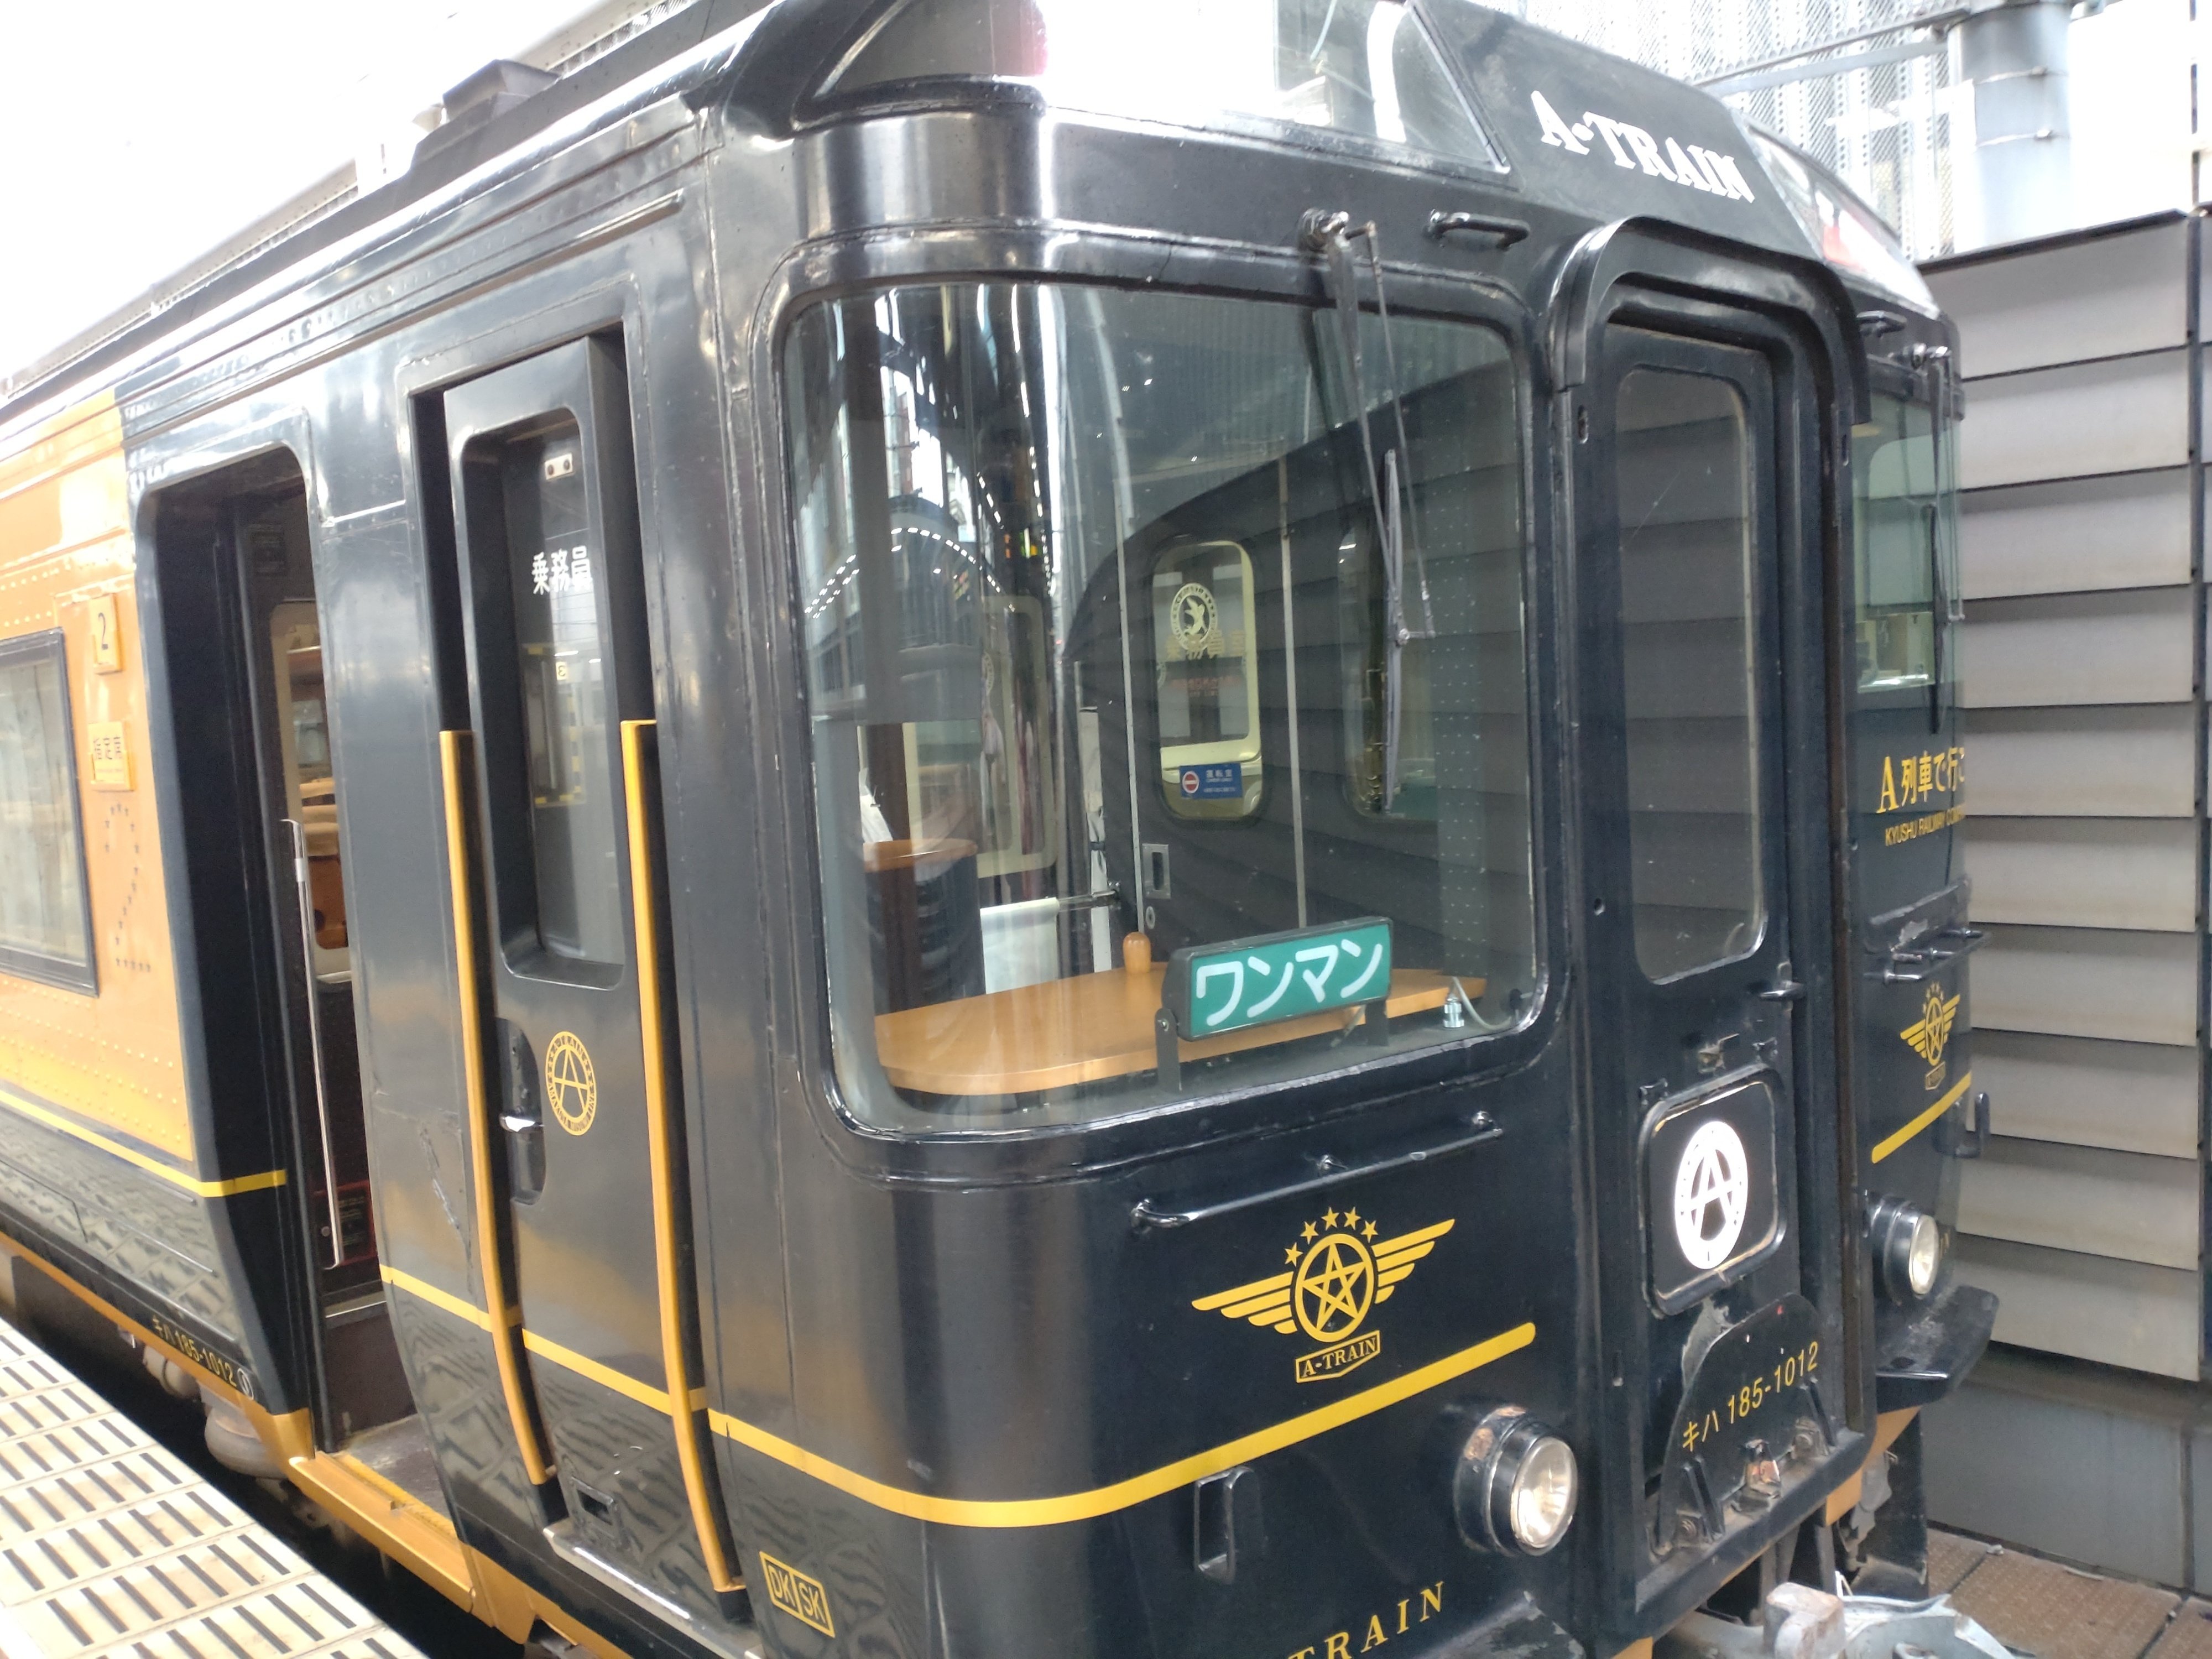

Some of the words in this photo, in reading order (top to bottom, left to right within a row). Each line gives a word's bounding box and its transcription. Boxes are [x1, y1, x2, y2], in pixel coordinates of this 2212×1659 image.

[1531, 90, 1755, 203] A-TRAIN
[531, 545, 592, 595] 乗務員
[98, 612, 108, 650] 2
[1196, 939, 1383, 1026] ワンマン
[175, 1329, 237, 1387] 185-1012
[1301, 1337, 1376, 1378] A-TRAIN
[1683, 1410, 1719, 1452] キハ
[1728, 1341, 1818, 1424] 185-1012
[768, 1565, 796, 1607] DK
[799, 1583, 826, 1624] SK
